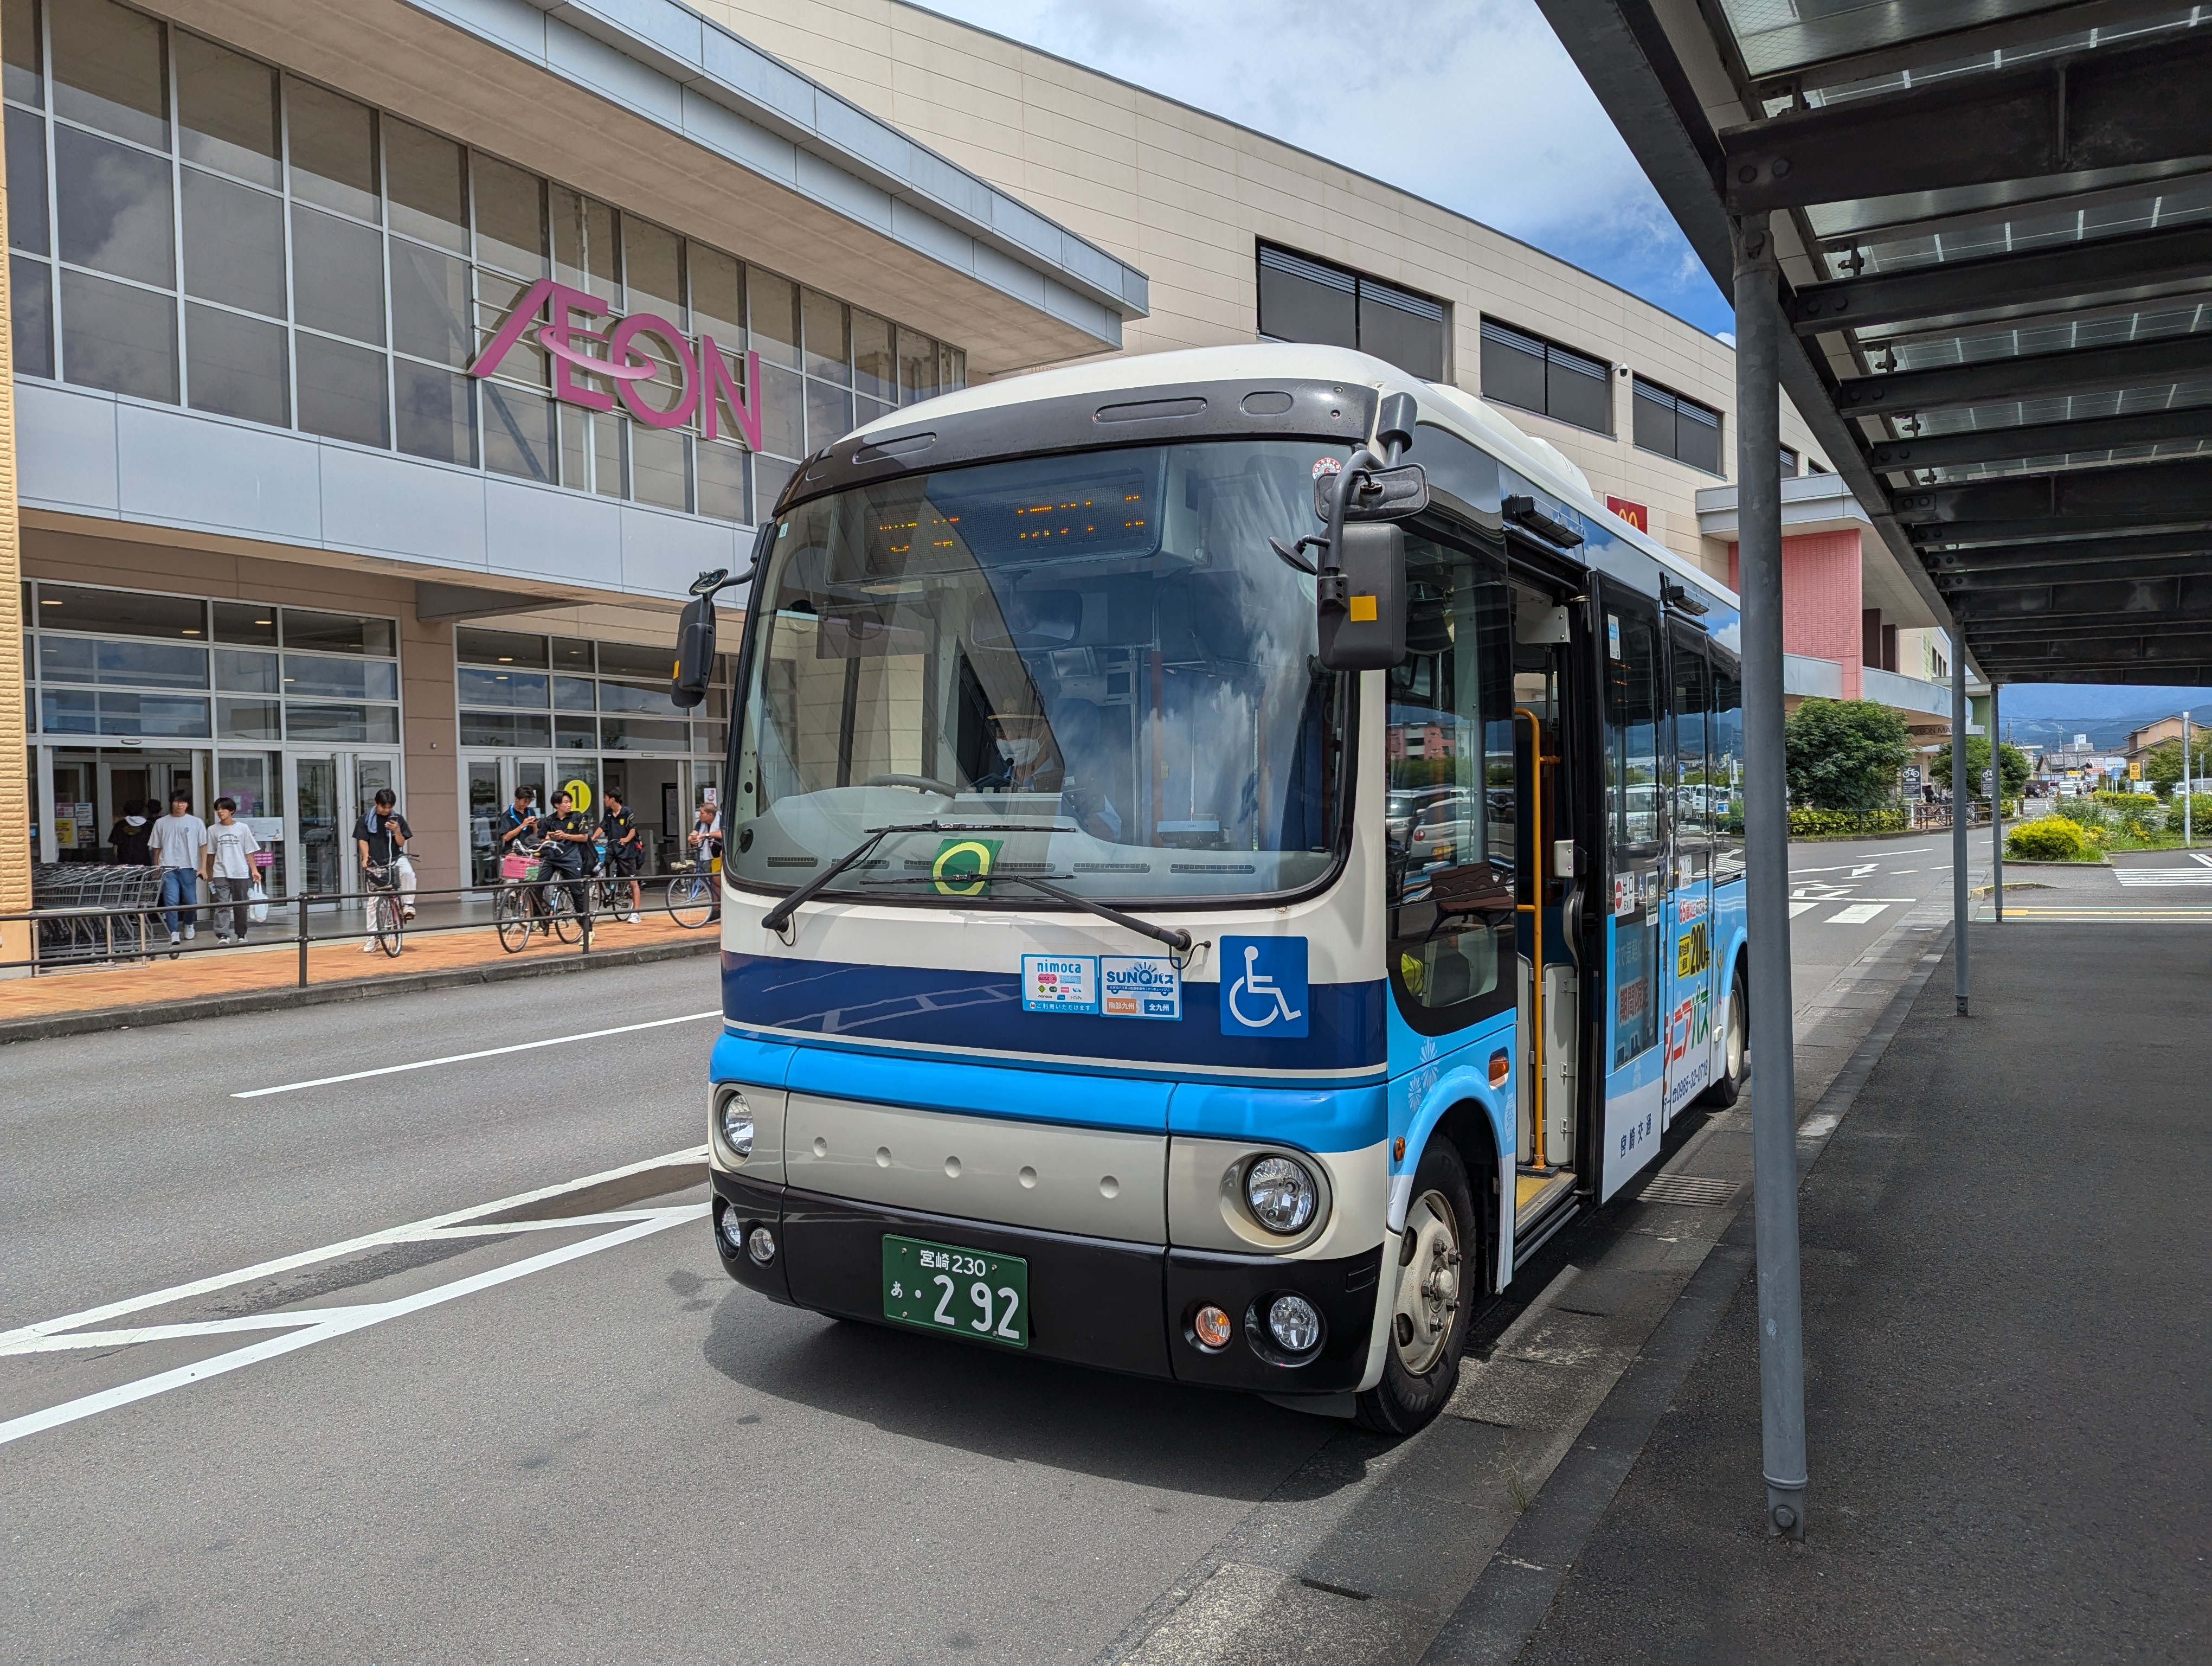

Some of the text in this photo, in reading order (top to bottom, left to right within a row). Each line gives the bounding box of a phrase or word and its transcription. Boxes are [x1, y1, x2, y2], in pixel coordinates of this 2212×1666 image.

[571, 785, 580, 808] 1
[1623, 876, 1634, 896] 出口
[1624, 899, 1632, 911] EXIT
[1037, 959, 1081, 973] nimoca
[1106, 970, 1174, 985] SUNQパス
[1037, 1003, 1091, 1011] ご利用いただけます
[1108, 1002, 1135, 1010] 南部九州
[1620, 977, 1649, 1022] 期間限定
[1149, 1003, 1169, 1012] 全九州
[1621, 1113, 1651, 1159] 宮崎交通
[891, 1280, 903, 1298] あ
